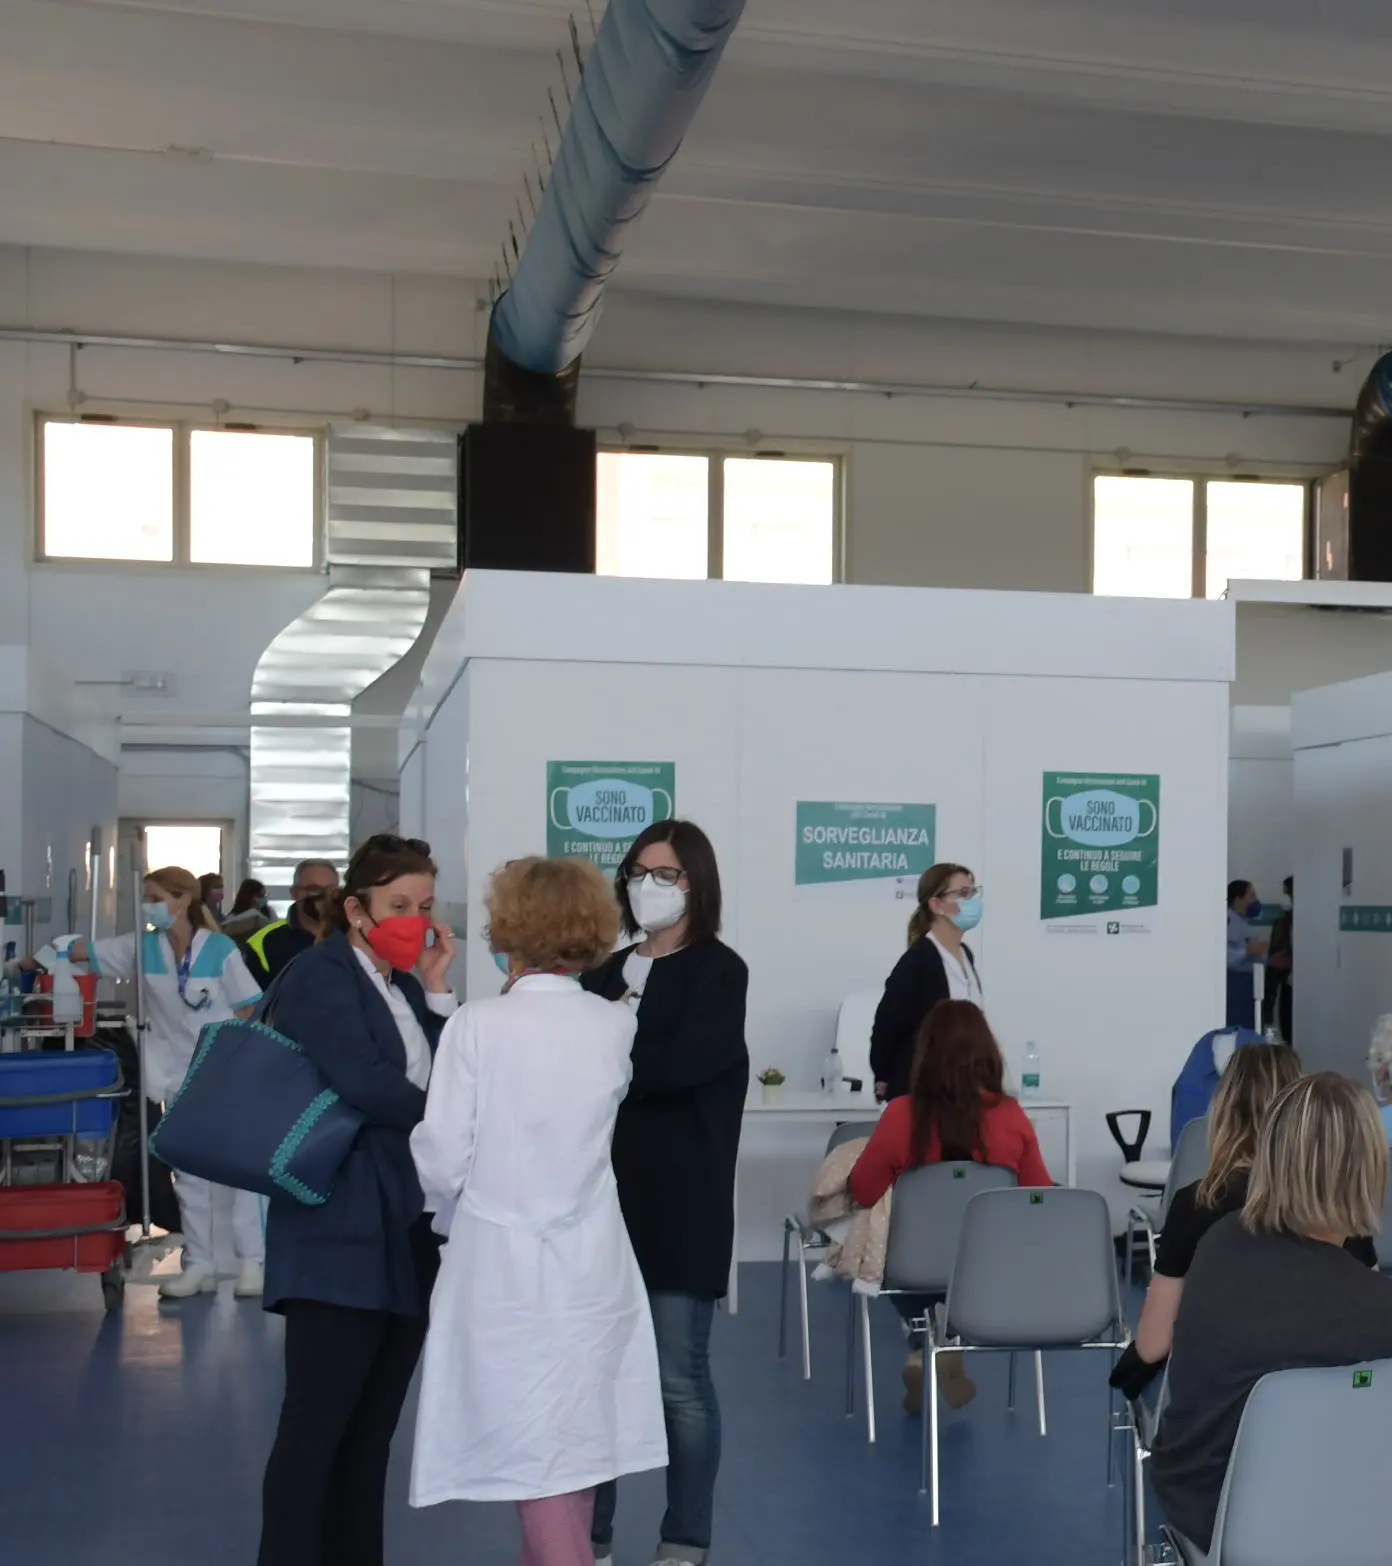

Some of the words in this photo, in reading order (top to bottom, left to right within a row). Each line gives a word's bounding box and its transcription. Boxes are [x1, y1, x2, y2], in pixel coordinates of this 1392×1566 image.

[595, 790, 626, 806] SONO
[1086, 800, 1116, 815] SONO
[575, 805, 646, 824] VACCINATO
[1068, 814, 1133, 833] VACCINATO
[803, 826, 929, 846] SORVEGLIANZA
[823, 850, 909, 870] SANITARIA
